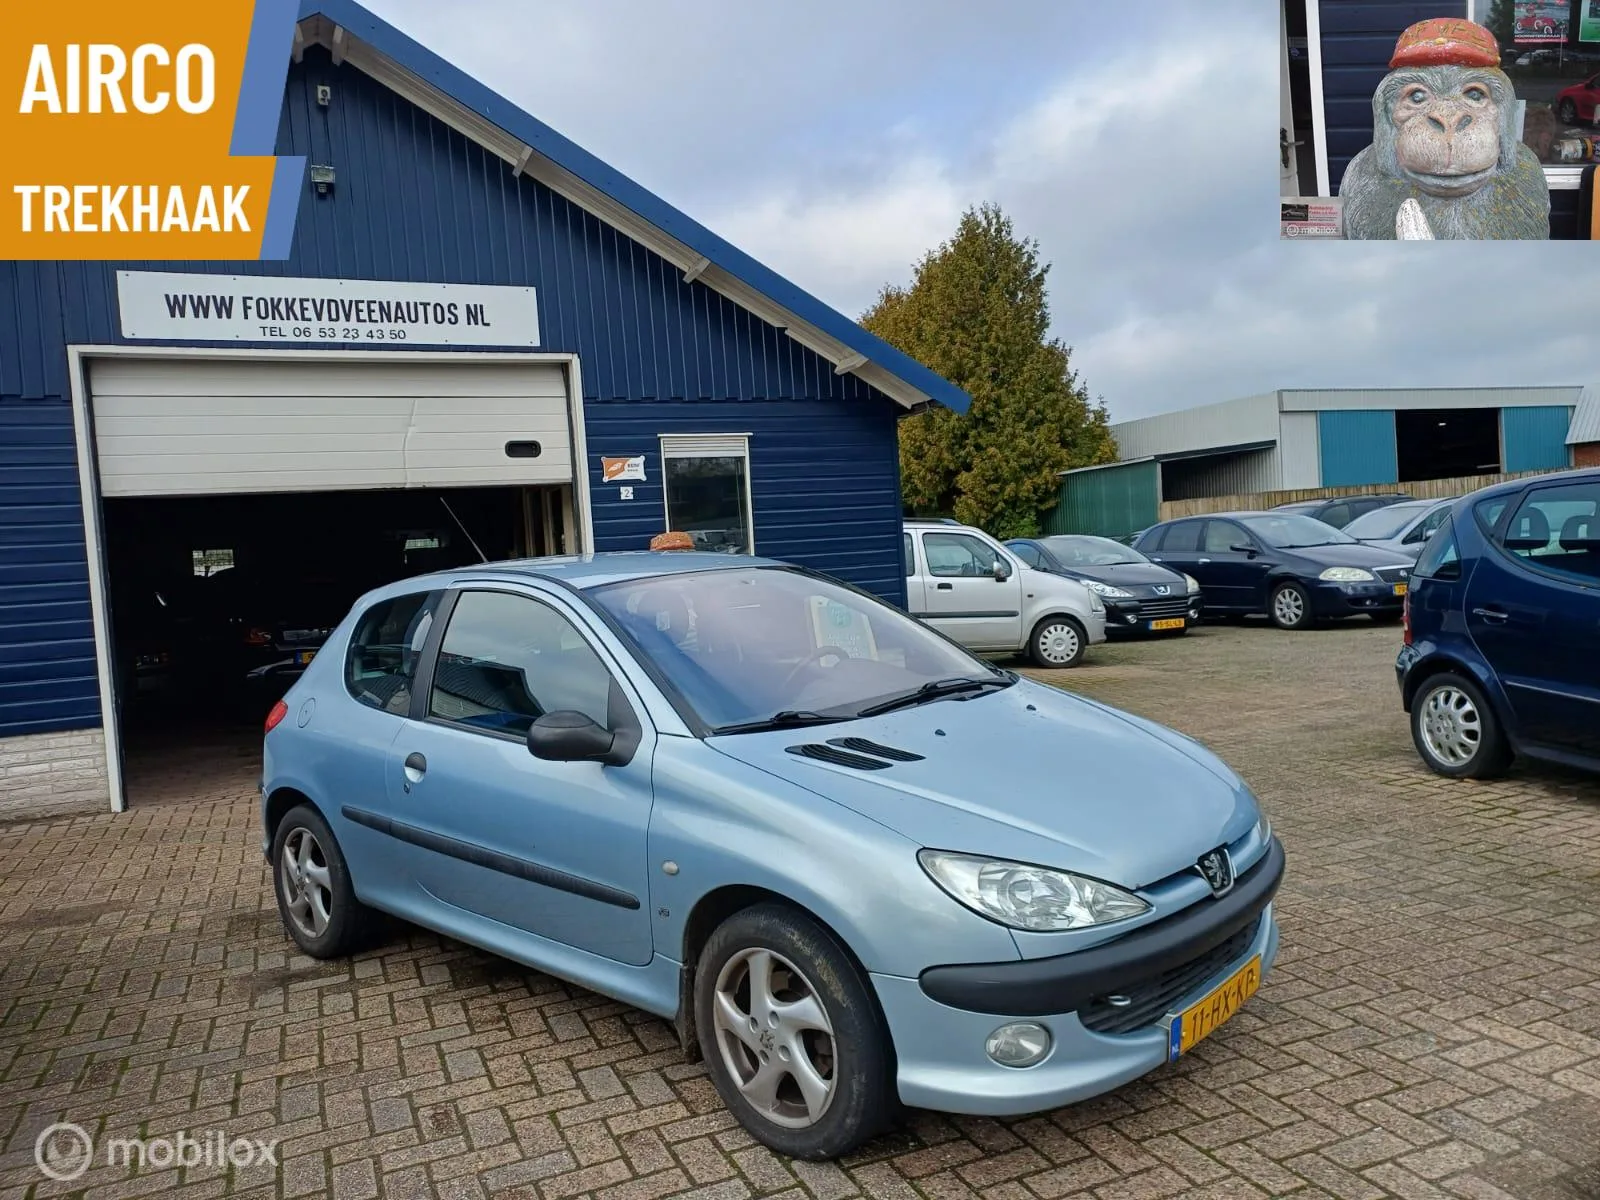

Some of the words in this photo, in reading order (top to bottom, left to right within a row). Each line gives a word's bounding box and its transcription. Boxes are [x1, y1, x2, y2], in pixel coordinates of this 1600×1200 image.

[164, 294, 234, 319] WWW
[242, 296, 458, 325] FOKKEVDVEENAUTOS
[466, 303, 491, 327] NL
[259, 326, 287, 337] TEL
[293, 327, 312, 338] 06
[319, 328, 336, 338] 53
[343, 328, 360, 340] 23
[366, 329, 385, 340] 43
[389, 330, 406, 340] 50
[624, 489, 630, 498] 2
